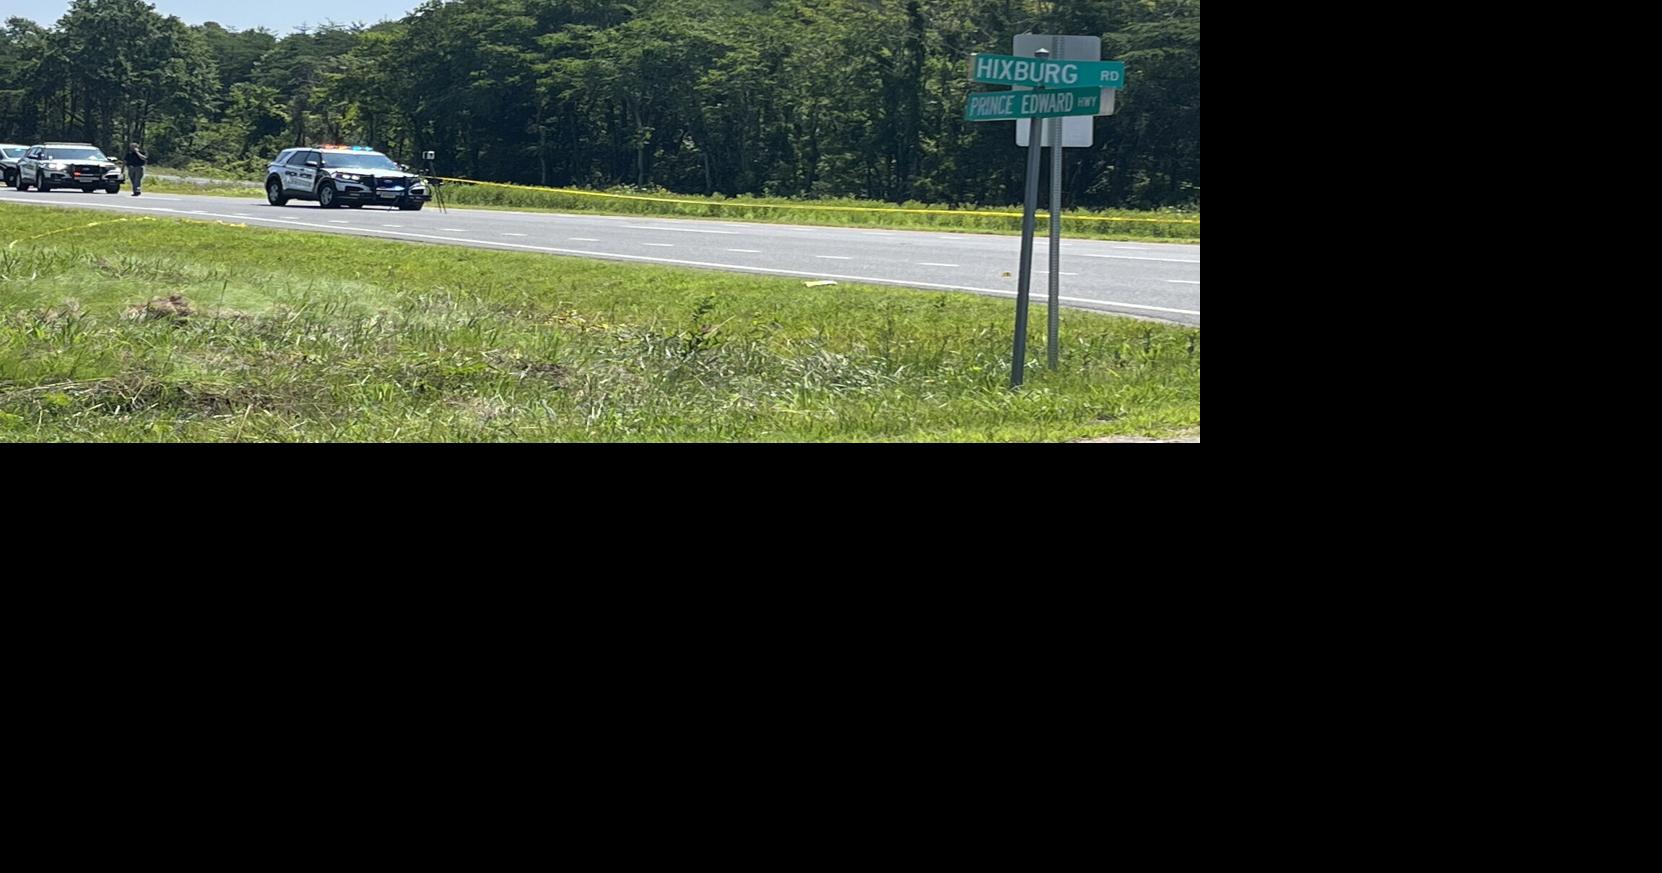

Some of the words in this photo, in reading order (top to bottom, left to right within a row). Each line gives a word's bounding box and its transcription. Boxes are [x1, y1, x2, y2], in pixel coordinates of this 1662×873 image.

[976, 57, 1078, 84] HIXBURG
[1100, 70, 1120, 81] RD
[969, 95, 1015, 116] PRINCE
[1021, 92, 1074, 114] EDWARD
[1077, 96, 1097, 108] HWY
